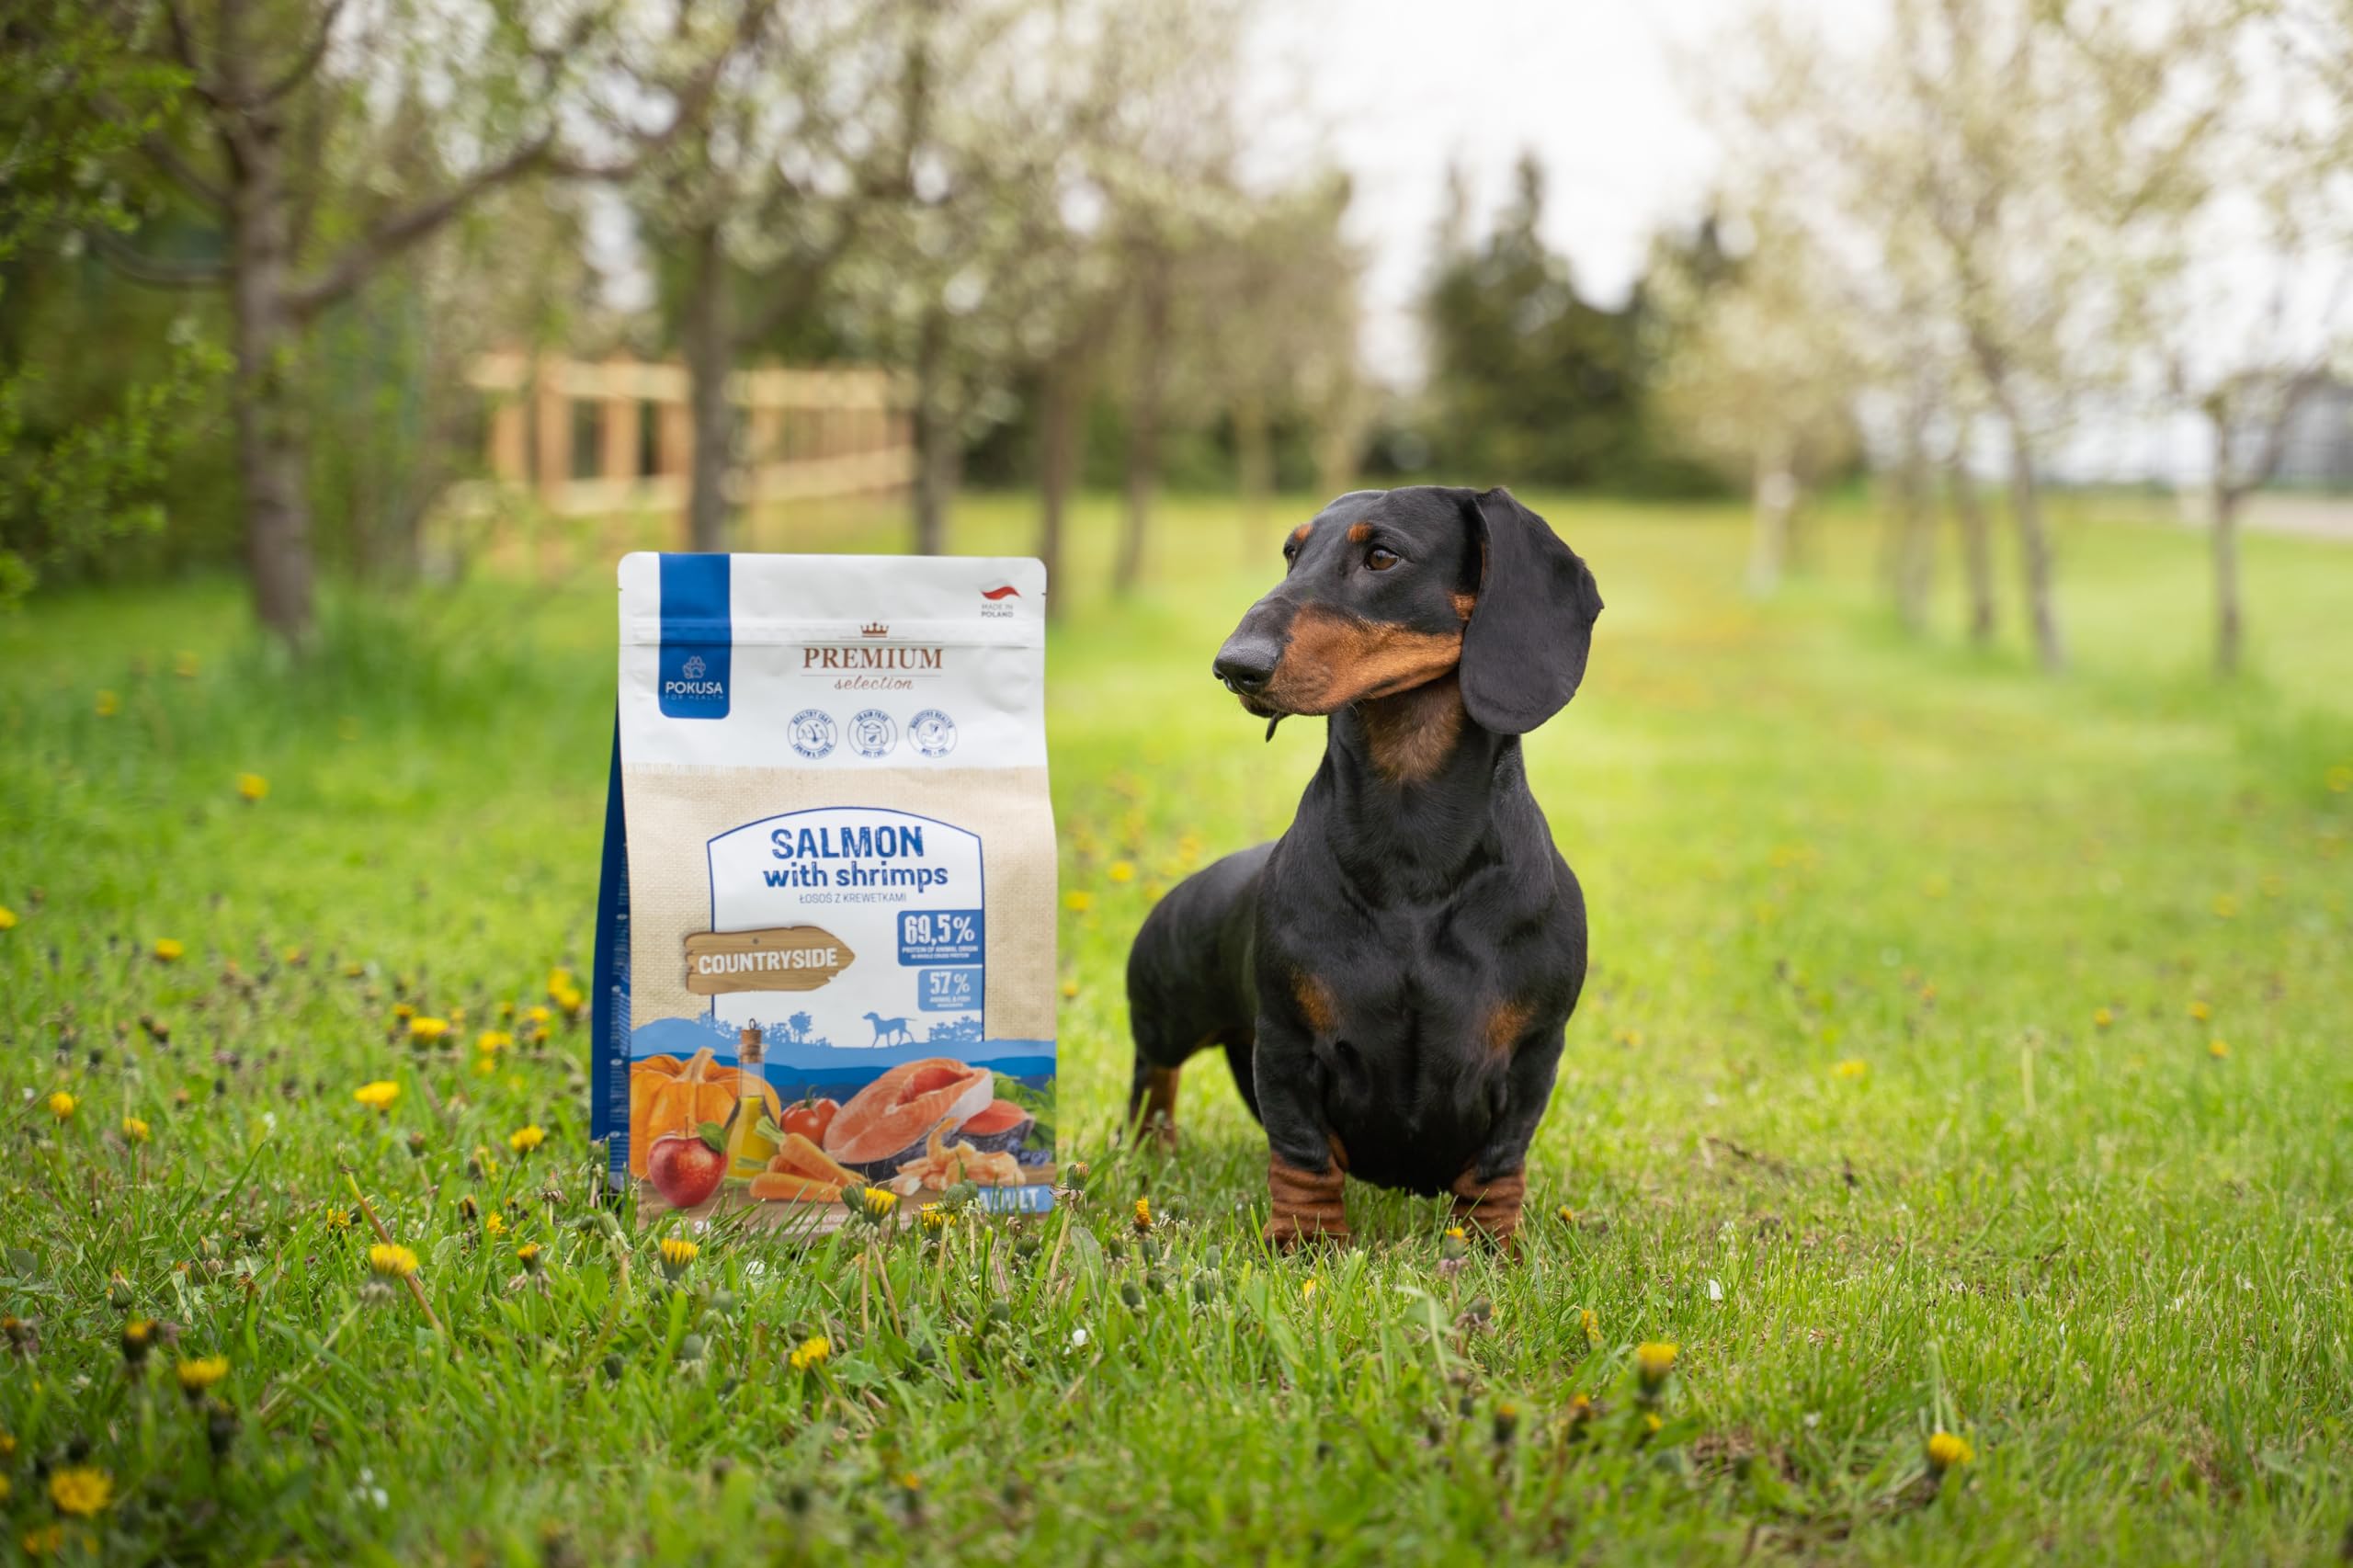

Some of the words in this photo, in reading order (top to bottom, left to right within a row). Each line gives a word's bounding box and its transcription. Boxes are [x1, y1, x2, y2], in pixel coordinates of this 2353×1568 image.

[802, 646, 943, 669] PREMIUM
[665, 681, 723, 694] POKUSA
[834, 676, 914, 690] selection
[770, 825, 925, 859] SALMON
[763, 861, 828, 888] with
[835, 860, 949, 893] shrimps
[799, 892, 833, 904] ŁOSOŚ
[835, 892, 841, 904] Z
[843, 892, 906, 903] KREWETKAMI
[904, 914, 975, 947] 69,5%
[698, 948, 839, 975] COUNTRYSIDE
